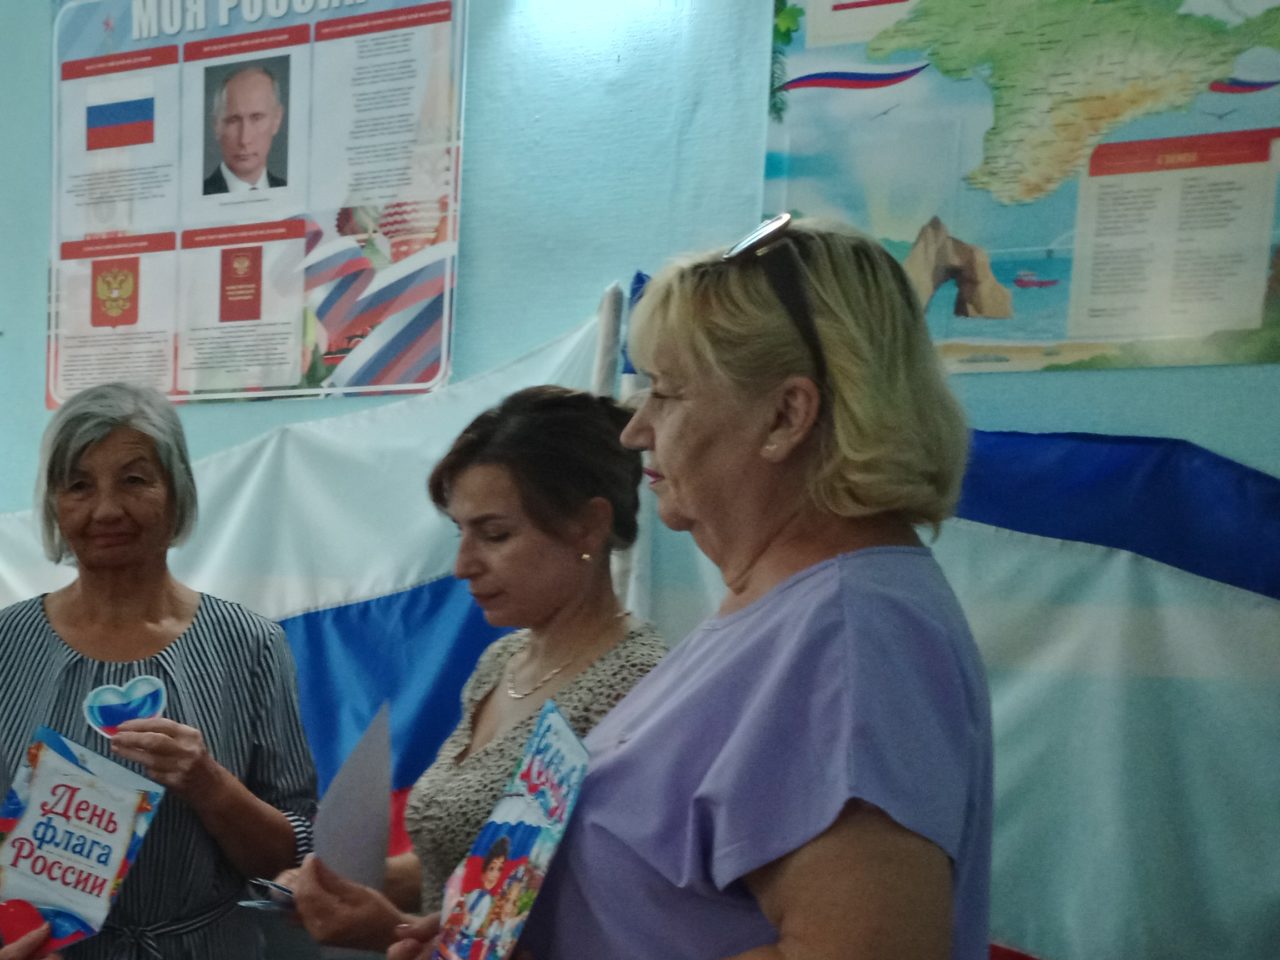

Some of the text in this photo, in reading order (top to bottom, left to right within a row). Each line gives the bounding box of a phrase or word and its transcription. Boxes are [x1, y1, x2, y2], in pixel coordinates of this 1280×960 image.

[40, 784, 118, 834] День
[32, 817, 113, 866] флага
[10, 837, 109, 898] России
